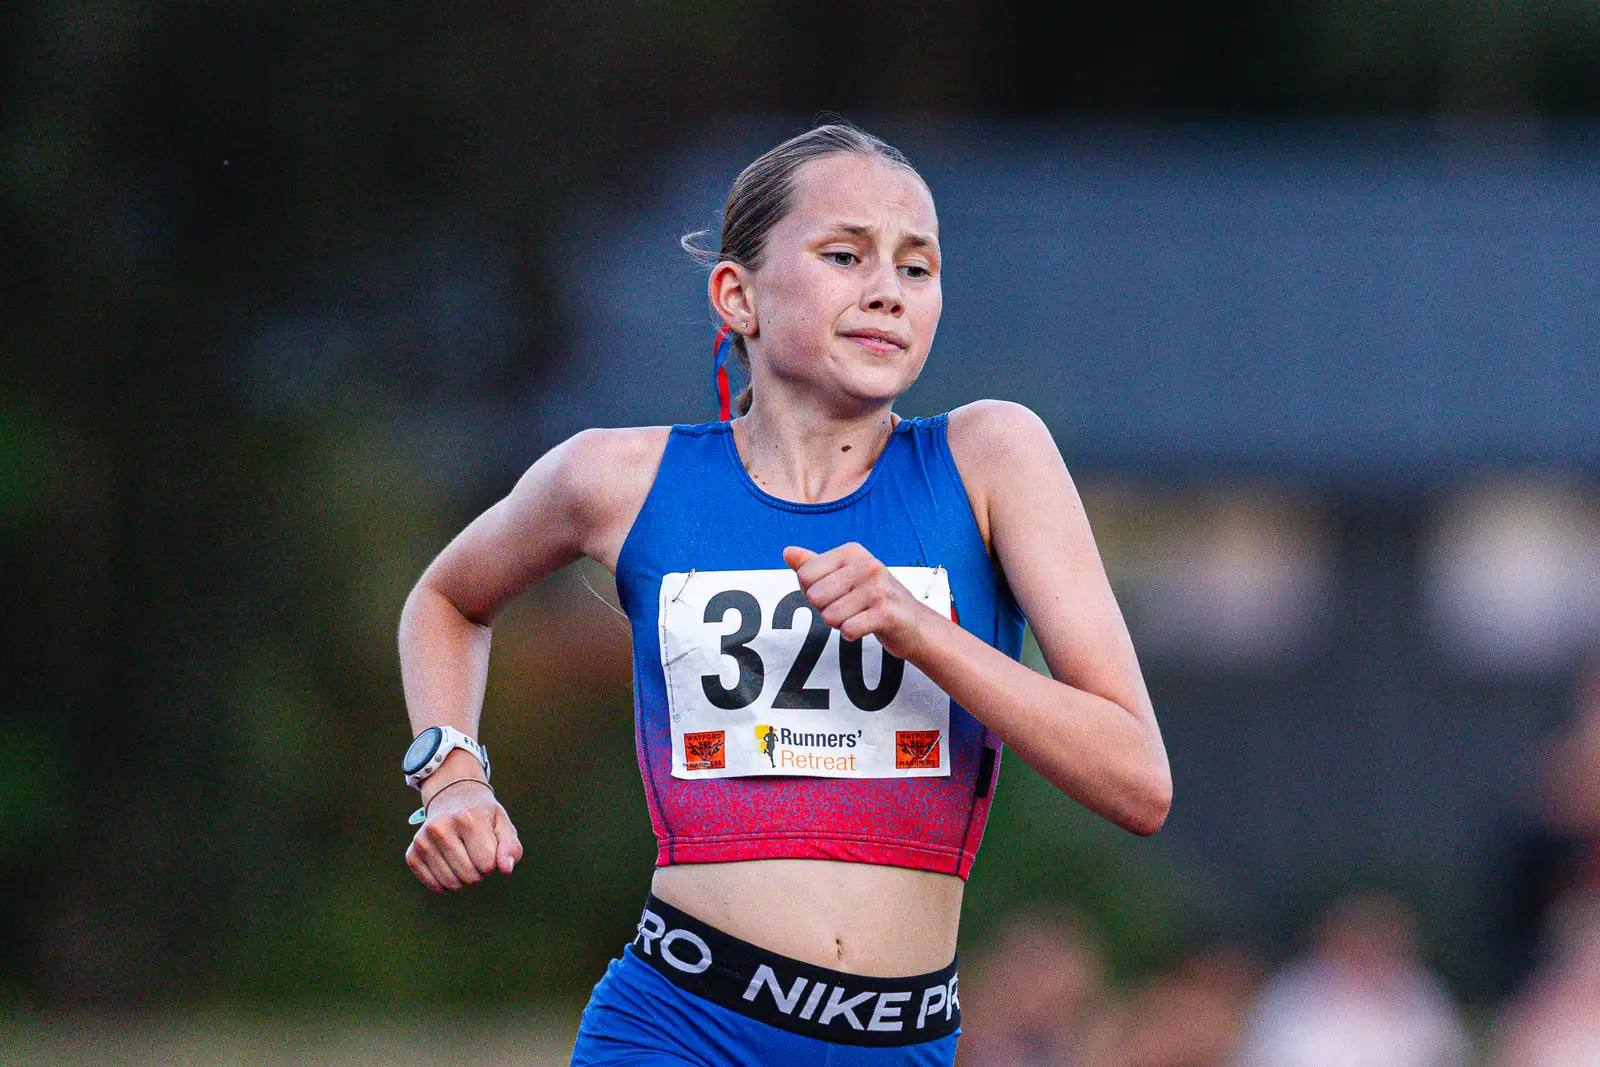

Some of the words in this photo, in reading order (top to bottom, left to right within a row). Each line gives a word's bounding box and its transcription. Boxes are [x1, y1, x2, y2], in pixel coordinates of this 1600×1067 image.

[701, 590, 905, 712] 320
[688, 733, 722, 741] WATFORD
[781, 749, 856, 771] Retreat
[742, 964, 912, 1032] NIKE
